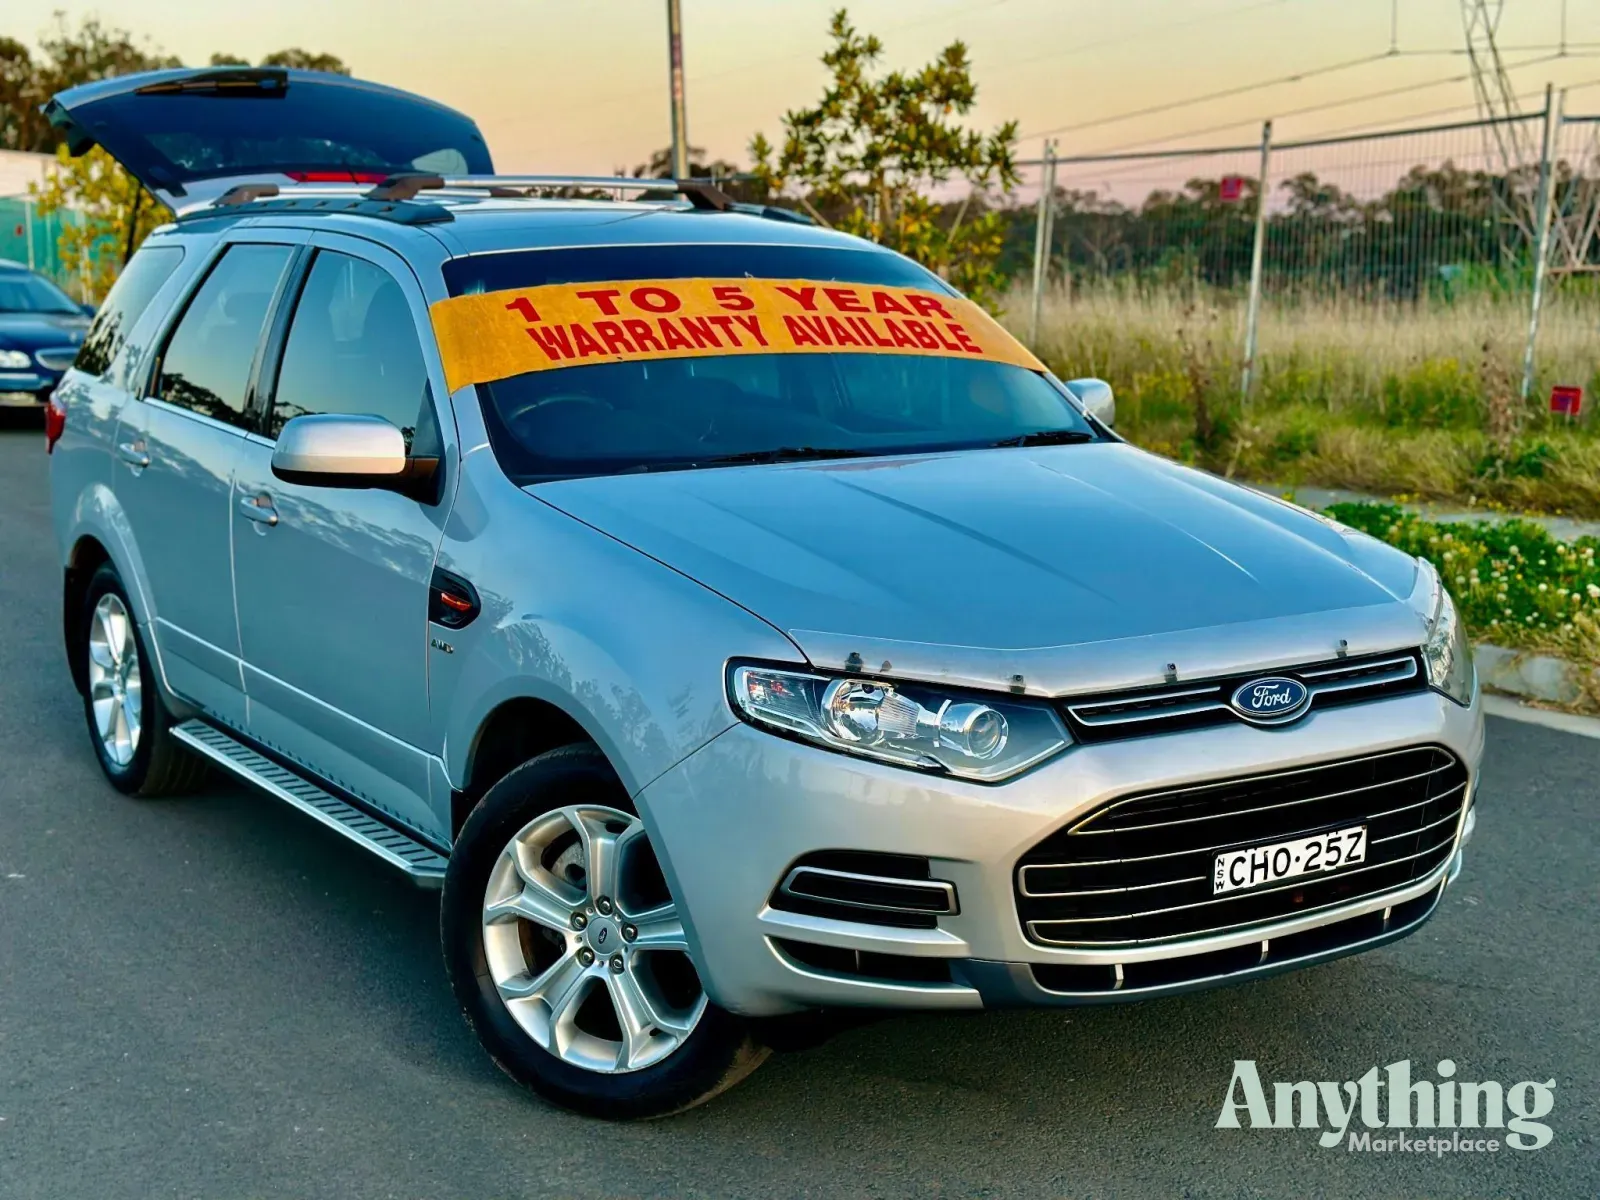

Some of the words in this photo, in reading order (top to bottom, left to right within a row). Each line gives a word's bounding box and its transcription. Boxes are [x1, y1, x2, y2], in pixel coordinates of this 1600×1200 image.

[504, 297, 541, 323] 1
[575, 287, 682, 316] TO
[711, 286, 755, 311] 5
[775, 286, 954, 320] YEAR
[525, 314, 769, 361] WARRANTY
[782, 314, 984, 354] AVAILABLE
[1251, 684, 1292, 709] Ford
